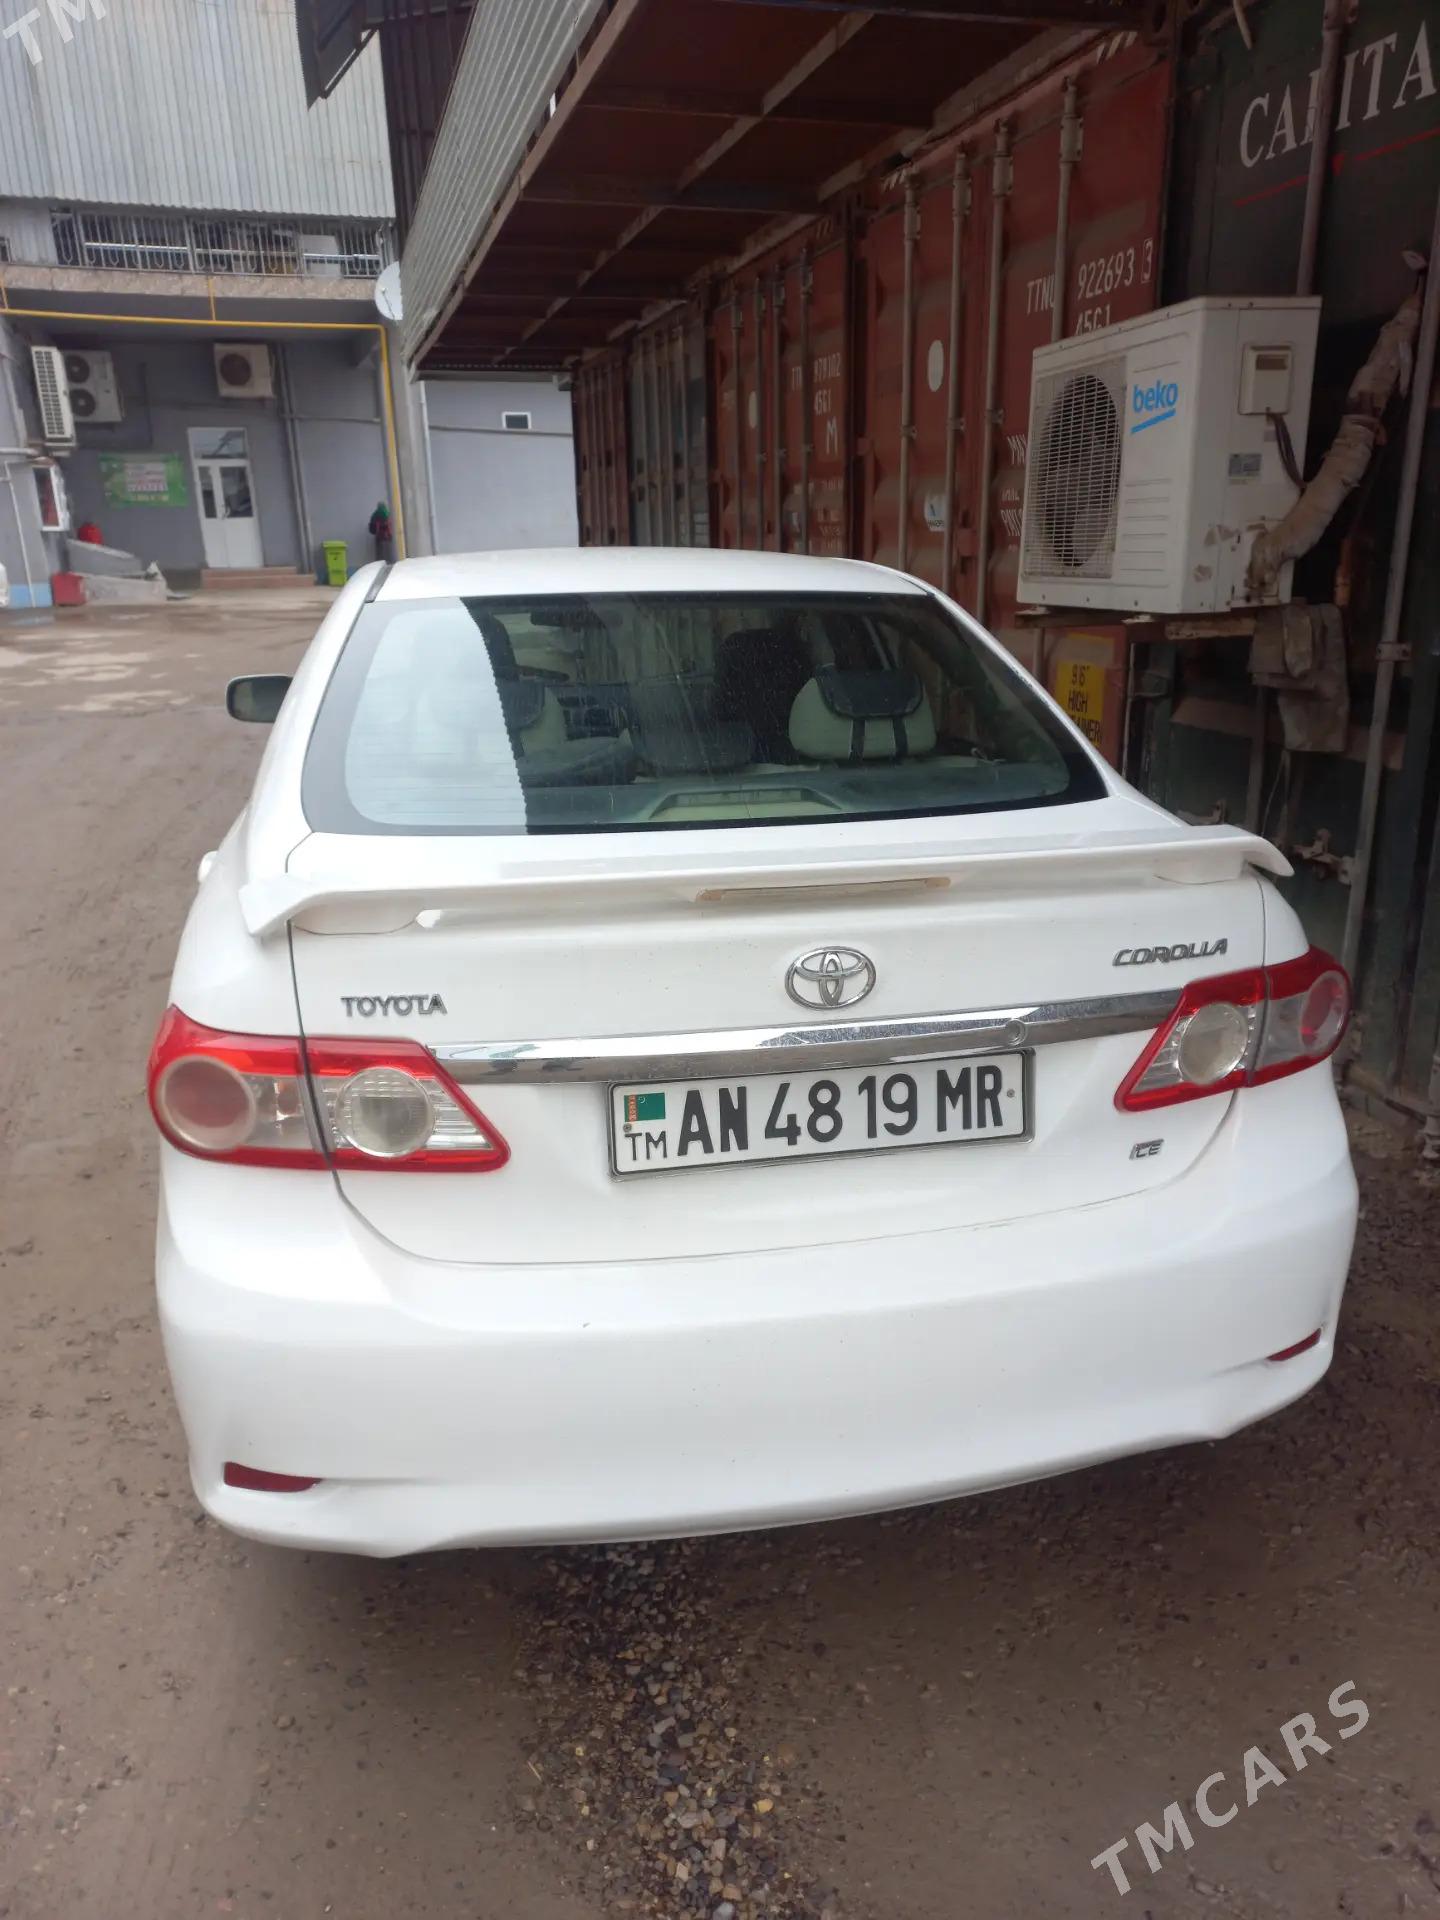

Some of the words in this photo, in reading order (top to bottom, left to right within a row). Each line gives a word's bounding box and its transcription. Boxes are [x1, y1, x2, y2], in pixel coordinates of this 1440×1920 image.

[1077, 247, 1135, 301] 922693
[1132, 380, 1179, 413] beko
[1068, 689, 1088, 713] HIGH
[1112, 938, 1228, 966] COROLLA
[340, 993, 448, 1017] TOYOTA
[624, 1130, 668, 1161] TM
[677, 1085, 749, 1156] AN
[936, 1064, 1003, 1132] MR
